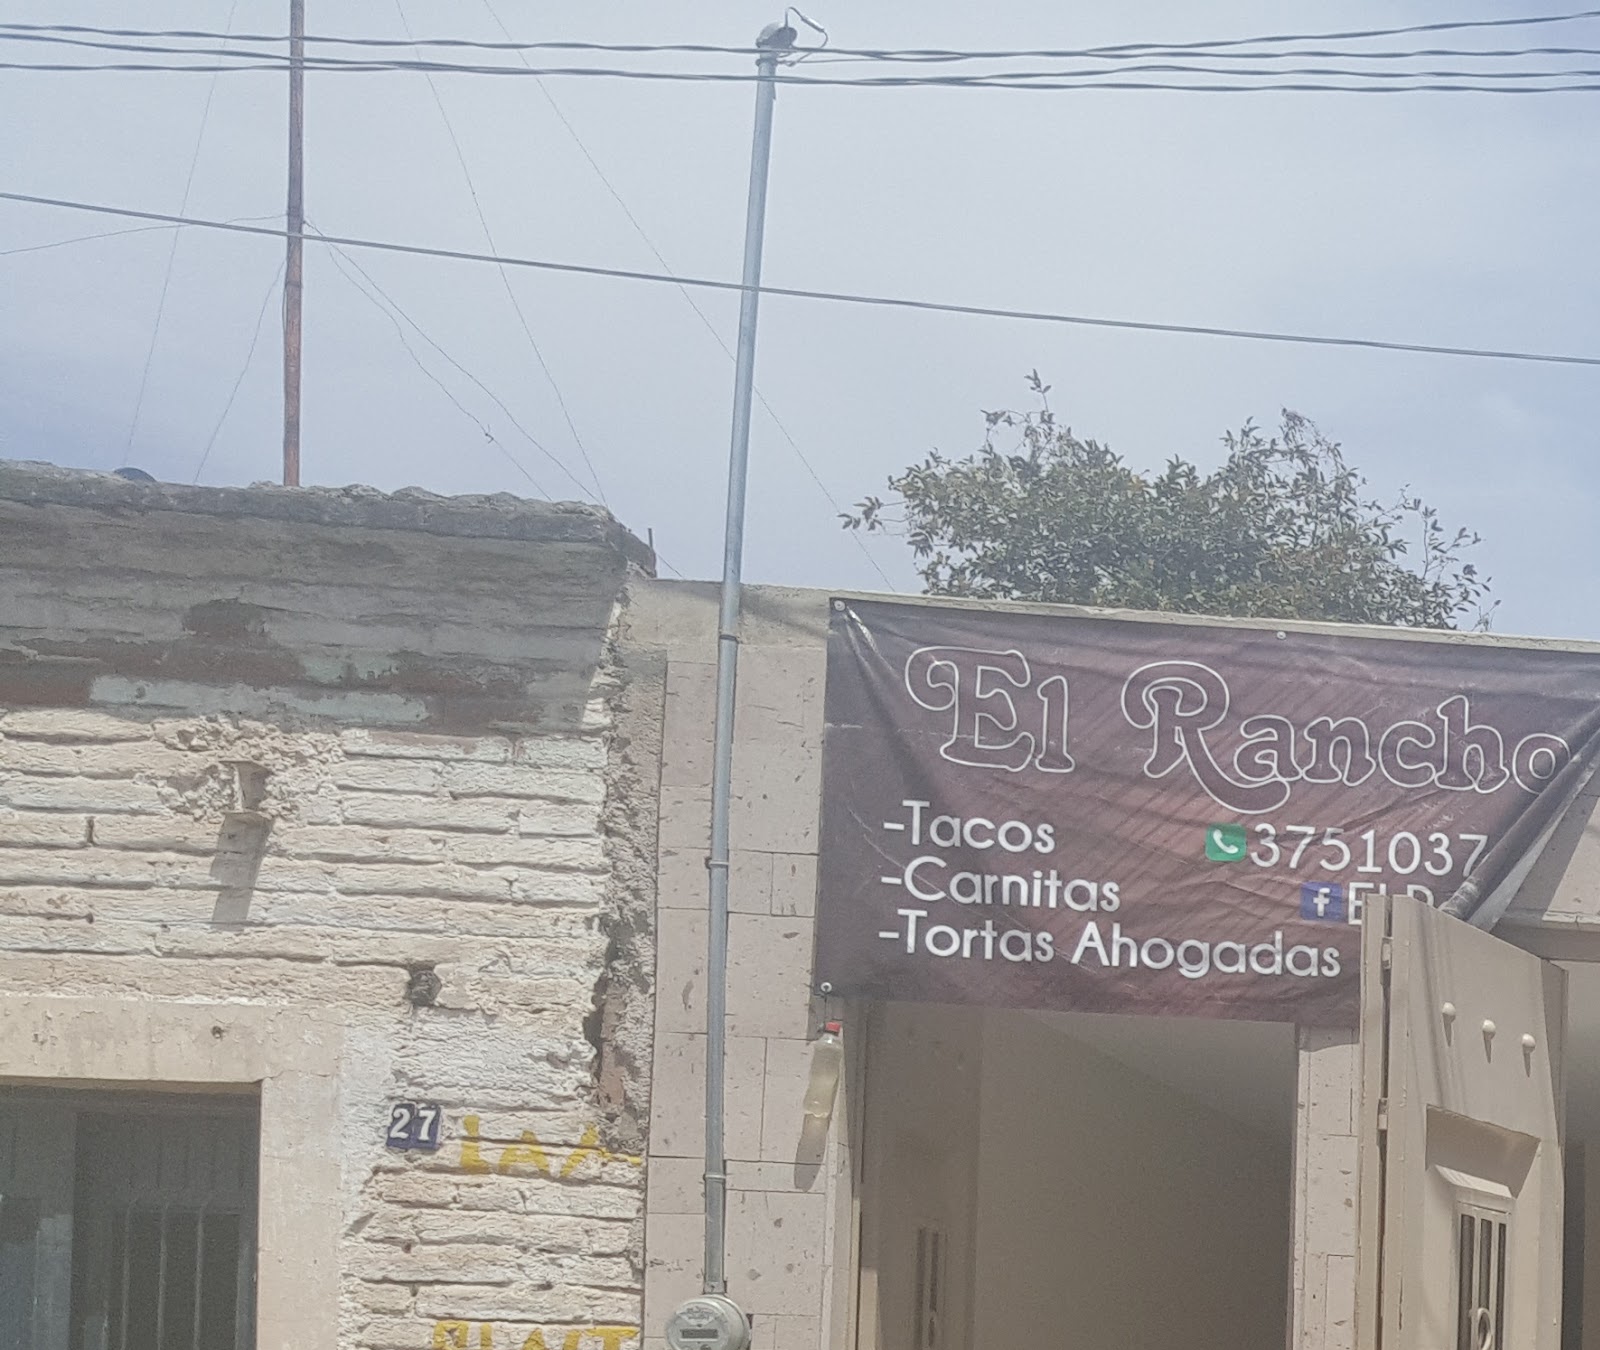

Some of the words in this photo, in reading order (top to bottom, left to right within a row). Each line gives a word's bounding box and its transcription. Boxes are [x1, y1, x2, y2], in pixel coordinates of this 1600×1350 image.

[904, 645, 1076, 774] El
[1120, 660, 1572, 815] Rancho
[883, 799, 1056, 854] -Tacos
[880, 855, 1121, 913] -Carnitas
[878, 908, 1055, 963] -Tortas
[1070, 920, 1341, 979] Ahogadas
[388, 1107, 437, 1142] 27
